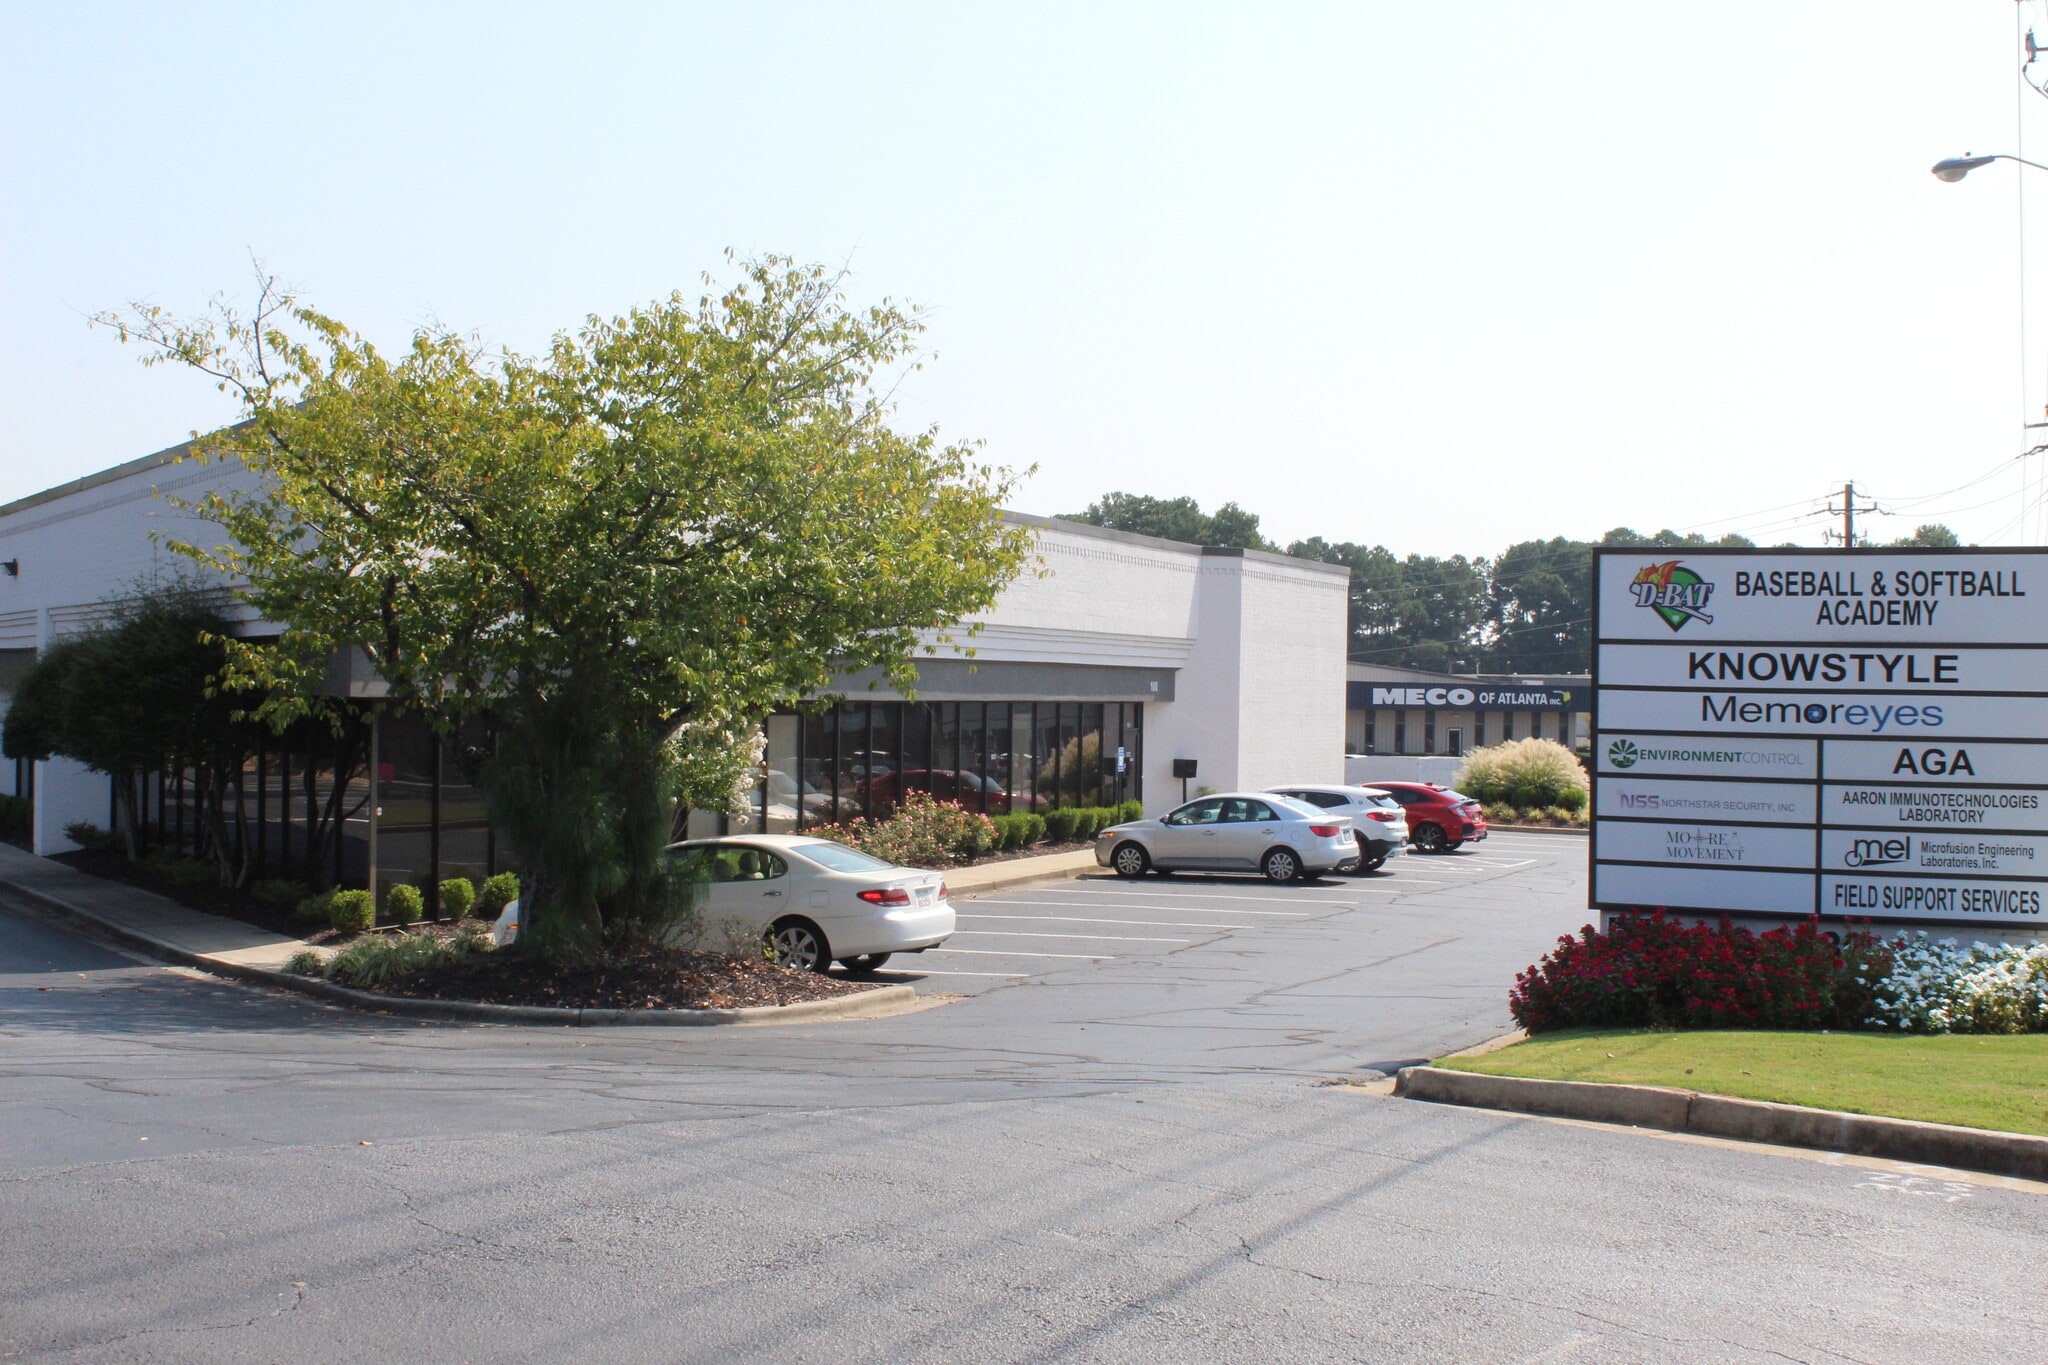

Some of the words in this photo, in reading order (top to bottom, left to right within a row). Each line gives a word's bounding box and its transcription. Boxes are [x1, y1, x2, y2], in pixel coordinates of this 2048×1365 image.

[1736, 571, 1863, 597] BASEBALL
[1871, 573, 1887, 597] &
[1895, 571, 2025, 597] SOFTBALL
[1636, 583, 1714, 608] D-BAT
[1816, 600, 1938, 626] ACADEMY
[1689, 652, 1959, 683] KNOWSTYLE
[1372, 688, 1475, 705] MECO
[1479, 692, 1495, 704] OF
[1498, 693, 1548, 705] ATLANTA
[1702, 696, 1944, 732] Memoreyes
[1893, 748, 1975, 776] AGA
[1620, 794, 1660, 809] NSS
[1661, 799, 1720, 809] NORTHSTAR
[1843, 791, 1886, 805] AARON
[1889, 793, 2038, 809] IMMUNOTECHNOLOGIES
[1899, 808, 1985, 823] LABORATORY
[1665, 847, 1744, 860] MOVEMENT
[1920, 841, 1975, 855] Microfusion
[1978, 843, 2034, 859] Engineering
[1920, 856, 1981, 869] Laboratories,
[1982, 859, 1999, 869] Inc.
[1835, 884, 1878, 909] FIELD
[1882, 886, 1956, 912] SUPPORT
[1961, 888, 2040, 914] SERVICES
